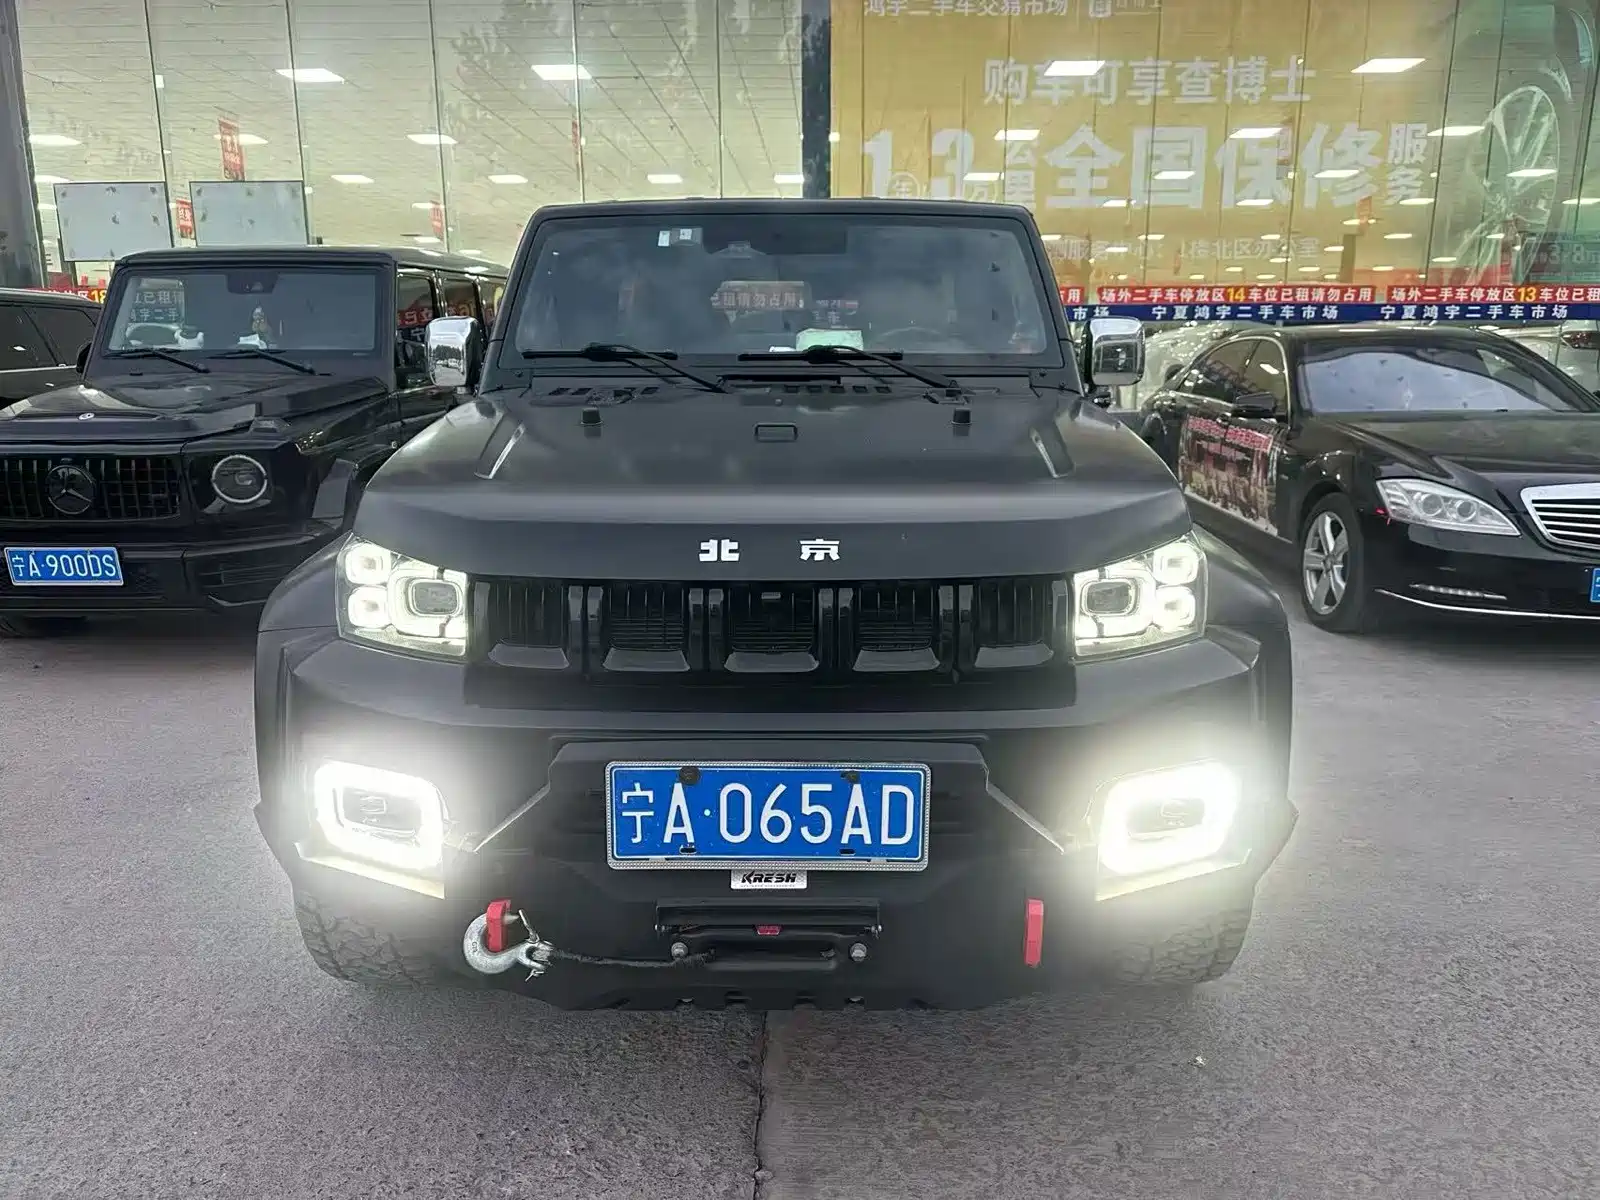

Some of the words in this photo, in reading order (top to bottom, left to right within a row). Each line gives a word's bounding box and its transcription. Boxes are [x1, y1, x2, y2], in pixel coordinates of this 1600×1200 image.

[984, 56, 1317, 105] 购车可享查博士
[1152, 305, 1338, 320] 宁夏鸿宇二手车市场
[1380, 305, 1568, 320] 宁夏鸿宇二手车市场
[741, 870, 797, 885] KRESH
